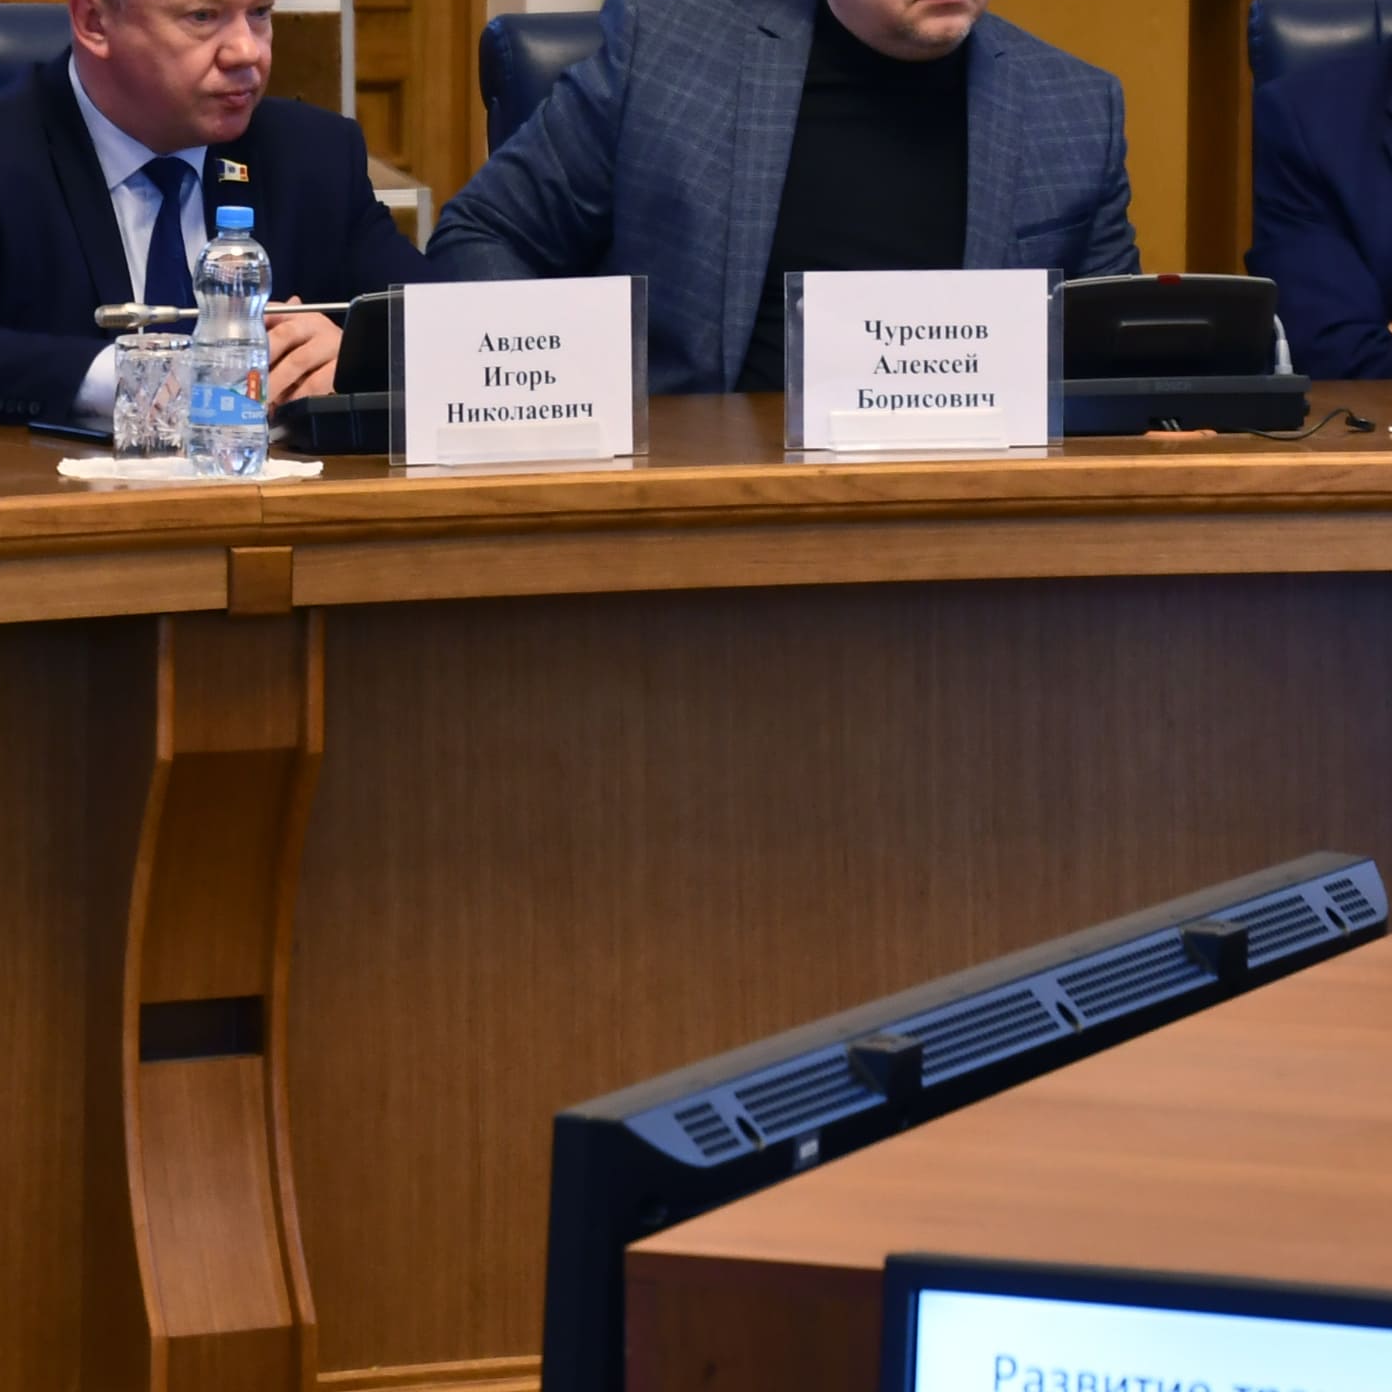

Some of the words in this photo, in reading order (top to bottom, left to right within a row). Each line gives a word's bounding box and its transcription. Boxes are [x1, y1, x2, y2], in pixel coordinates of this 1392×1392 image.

[477, 332, 562, 353] Авдеев
[863, 319, 989, 347] Чурсинов
[873, 353, 979, 375] Алексей
[483, 365, 557, 392] Игорь
[857, 388, 995, 411] Борисович
[447, 402, 593, 424] Николаевич
